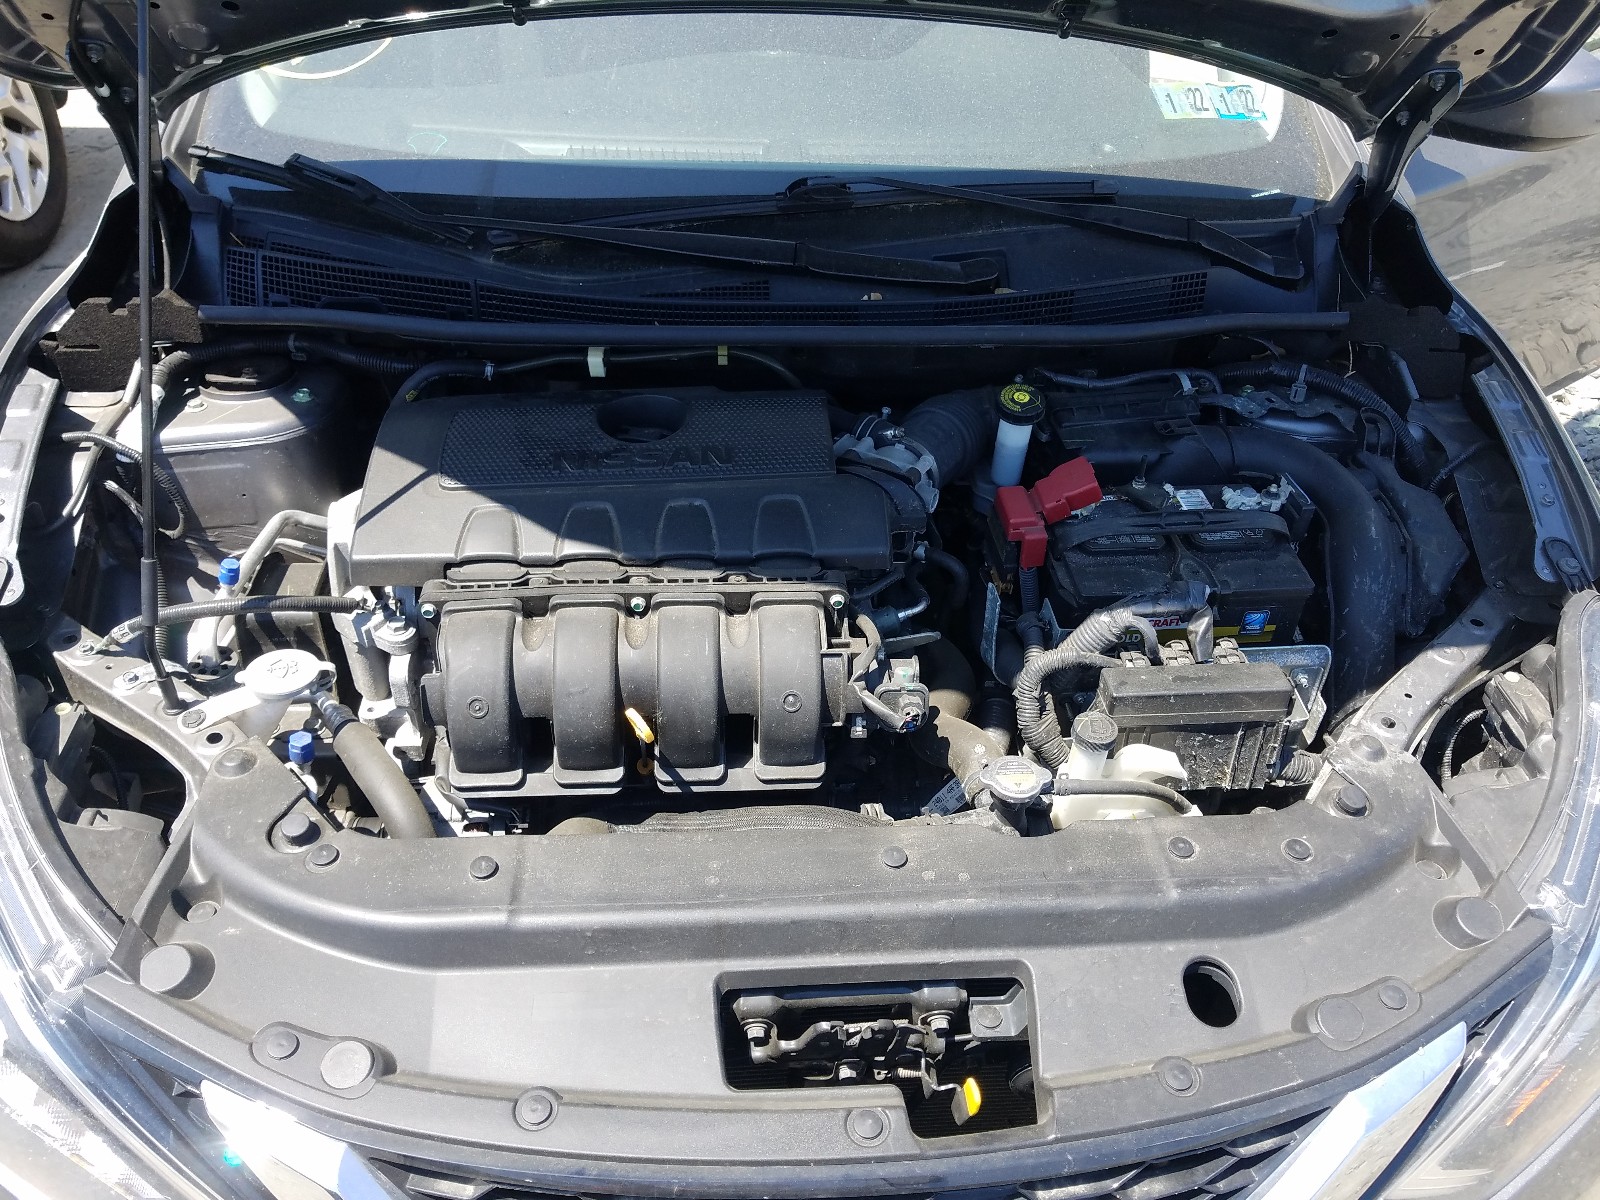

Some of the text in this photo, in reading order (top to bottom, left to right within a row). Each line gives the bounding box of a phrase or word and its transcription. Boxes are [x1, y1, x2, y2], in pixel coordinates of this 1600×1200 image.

[1165, 92, 1178, 114] 1
[1219, 92, 1232, 114] 1
[552, 448, 733, 474] NISSAN
